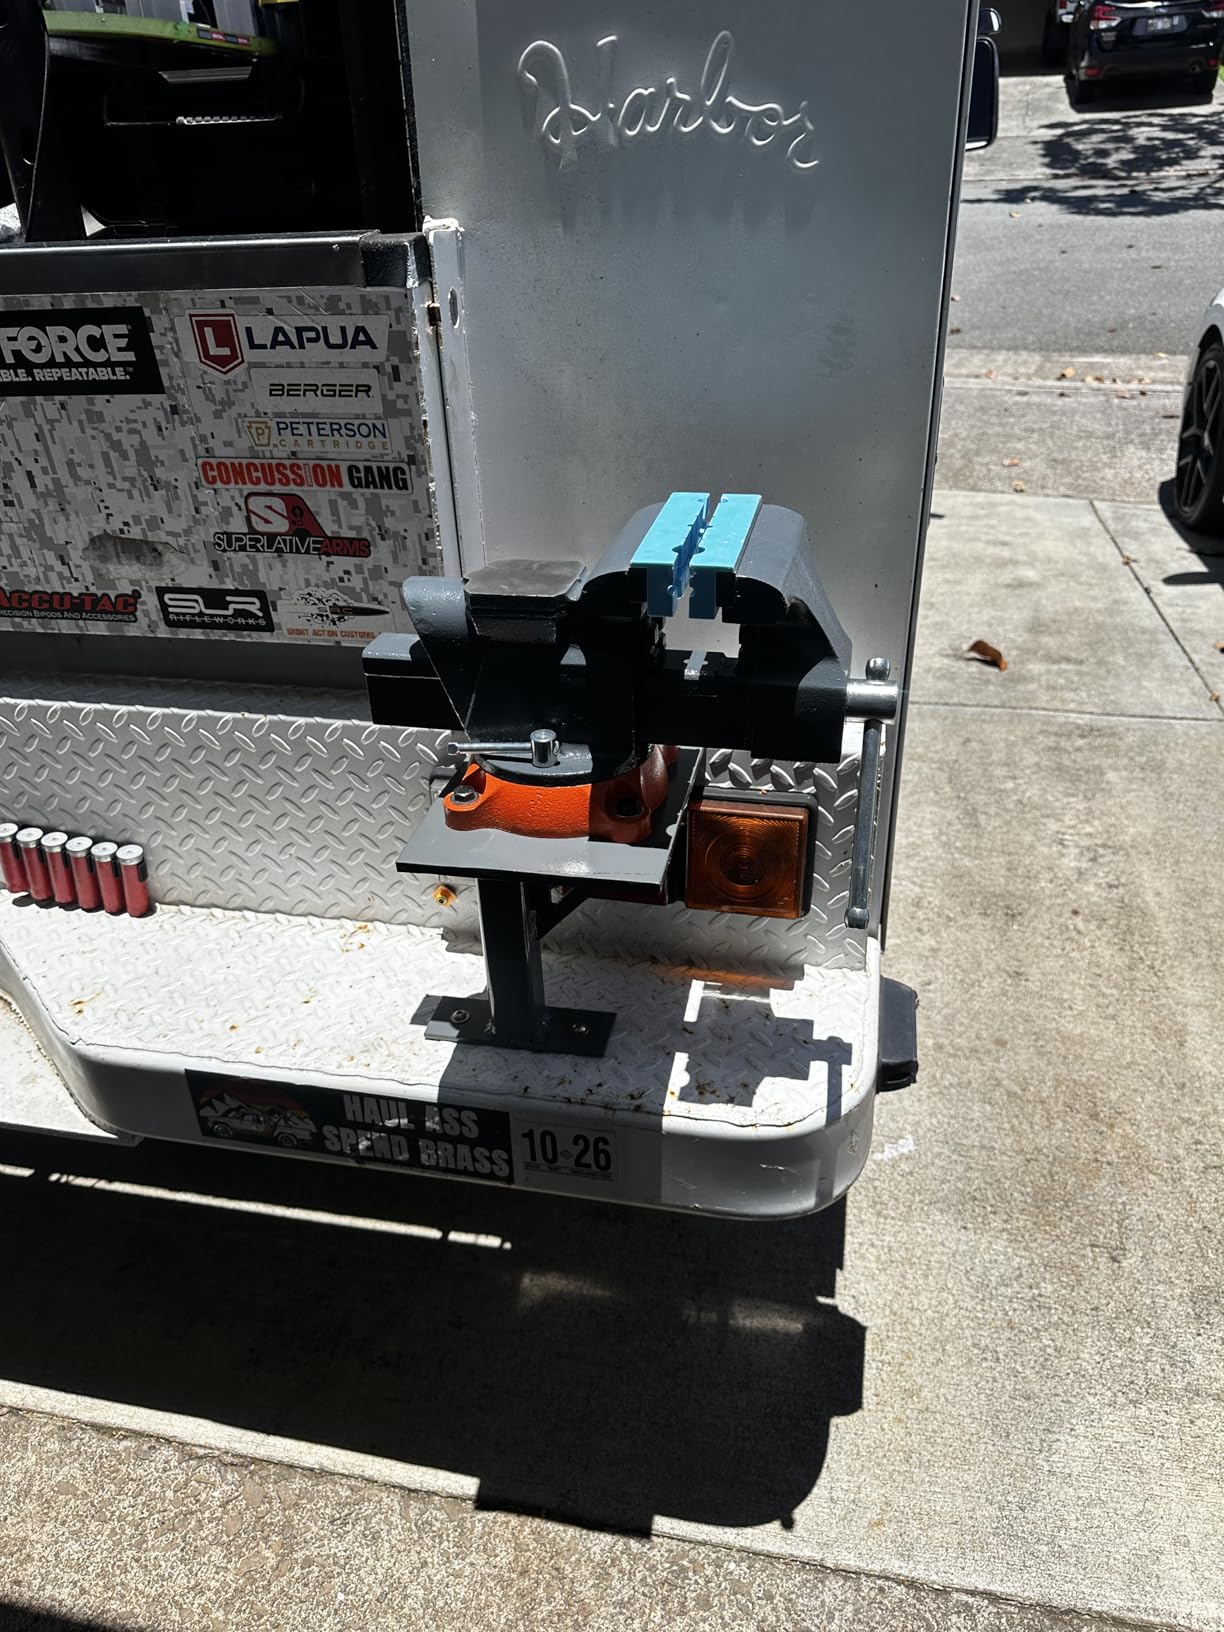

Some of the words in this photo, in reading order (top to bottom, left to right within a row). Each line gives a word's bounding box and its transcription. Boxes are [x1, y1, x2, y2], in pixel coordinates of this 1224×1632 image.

[245, 325, 378, 350] LAPUA
[0, 368, 33, 382] BLE.
[269, 383, 373, 398] BERGER
[276, 421, 387, 439] PETERSON
[279, 439, 389, 450] CARTRIDGE
[201, 461, 344, 489] CONCUSSION
[348, 464, 409, 491] GANG
[164, 593, 263, 617] SLR
[169, 614, 266, 625] RIFLEWORKS
[312, 629, 338, 638] ACTION
[340, 630, 377, 639] CUSTOMS
[343, 1094, 415, 1130] HAUL
[425, 1104, 480, 1139] ASS
[322, 1124, 409, 1161] SPEND
[419, 1138, 510, 1177] BRASS
[521, 1128, 558, 1165] 10
[572, 1134, 611, 1171] 26
